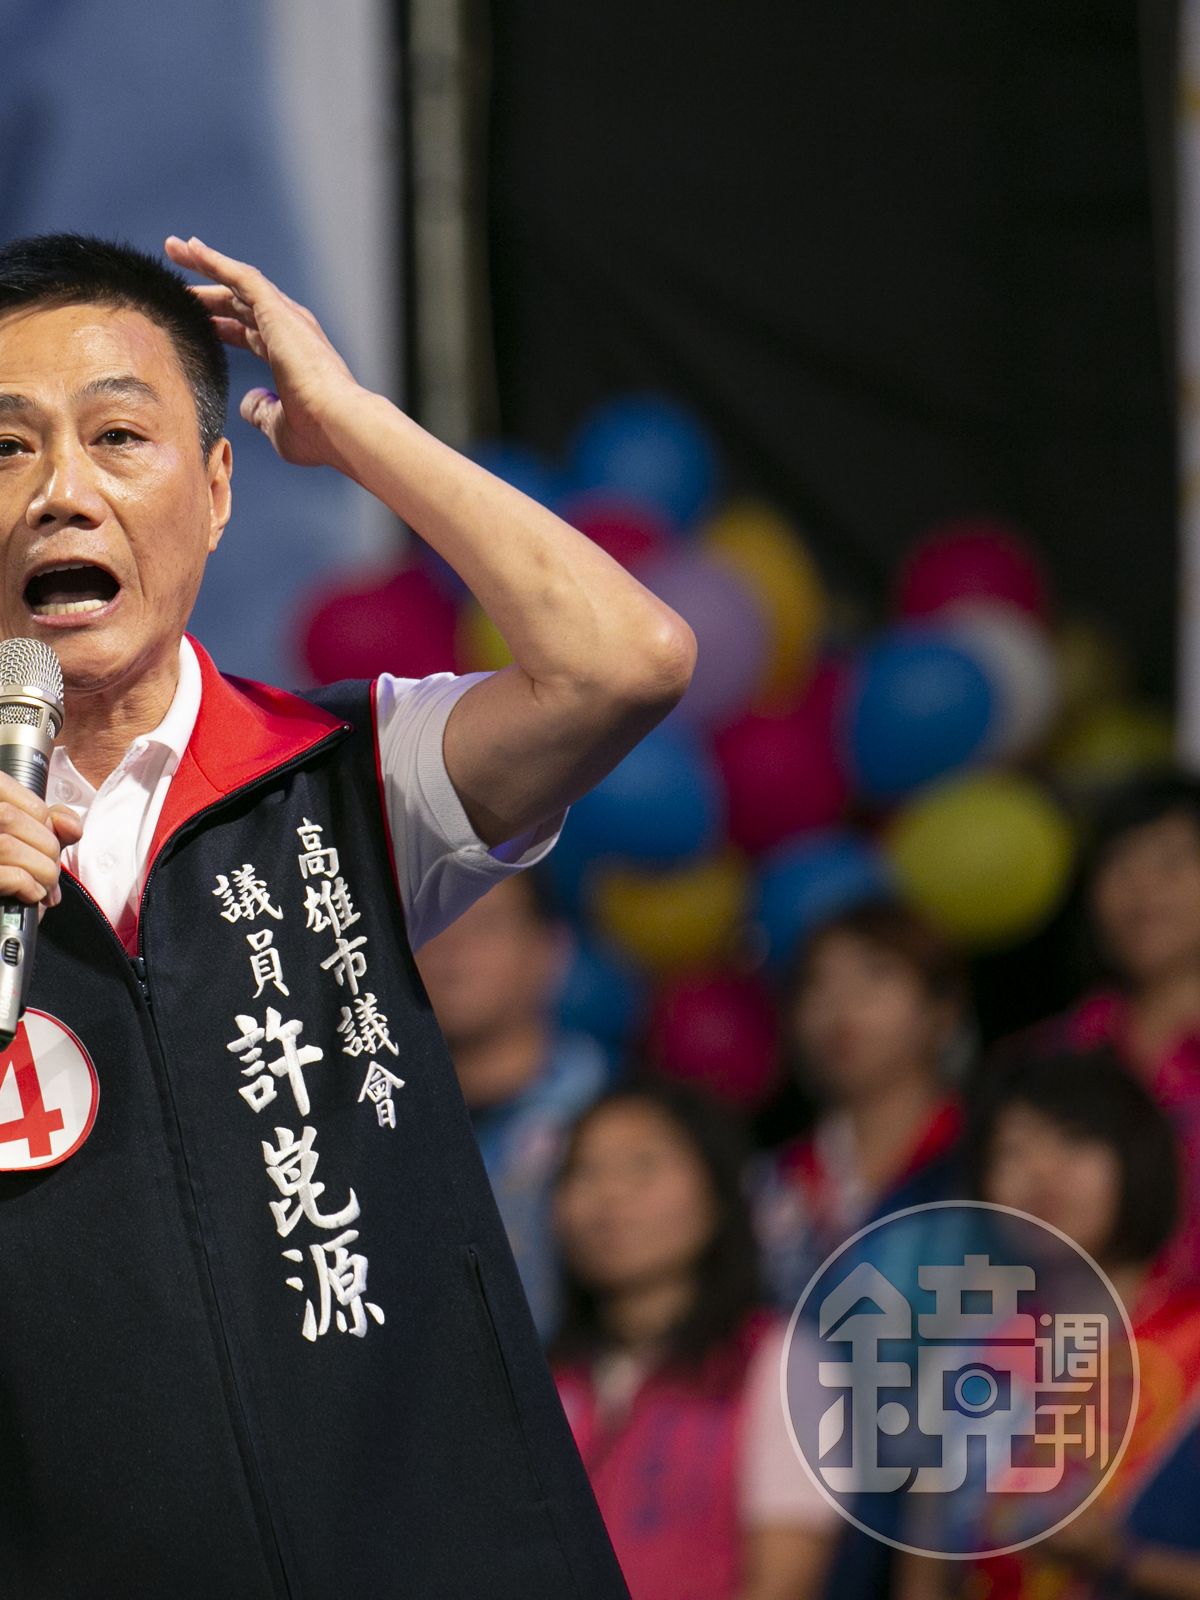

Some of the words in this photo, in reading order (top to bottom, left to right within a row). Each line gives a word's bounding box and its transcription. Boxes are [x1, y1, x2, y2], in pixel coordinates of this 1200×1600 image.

[296, 817, 405, 1130] 高雄市議會
